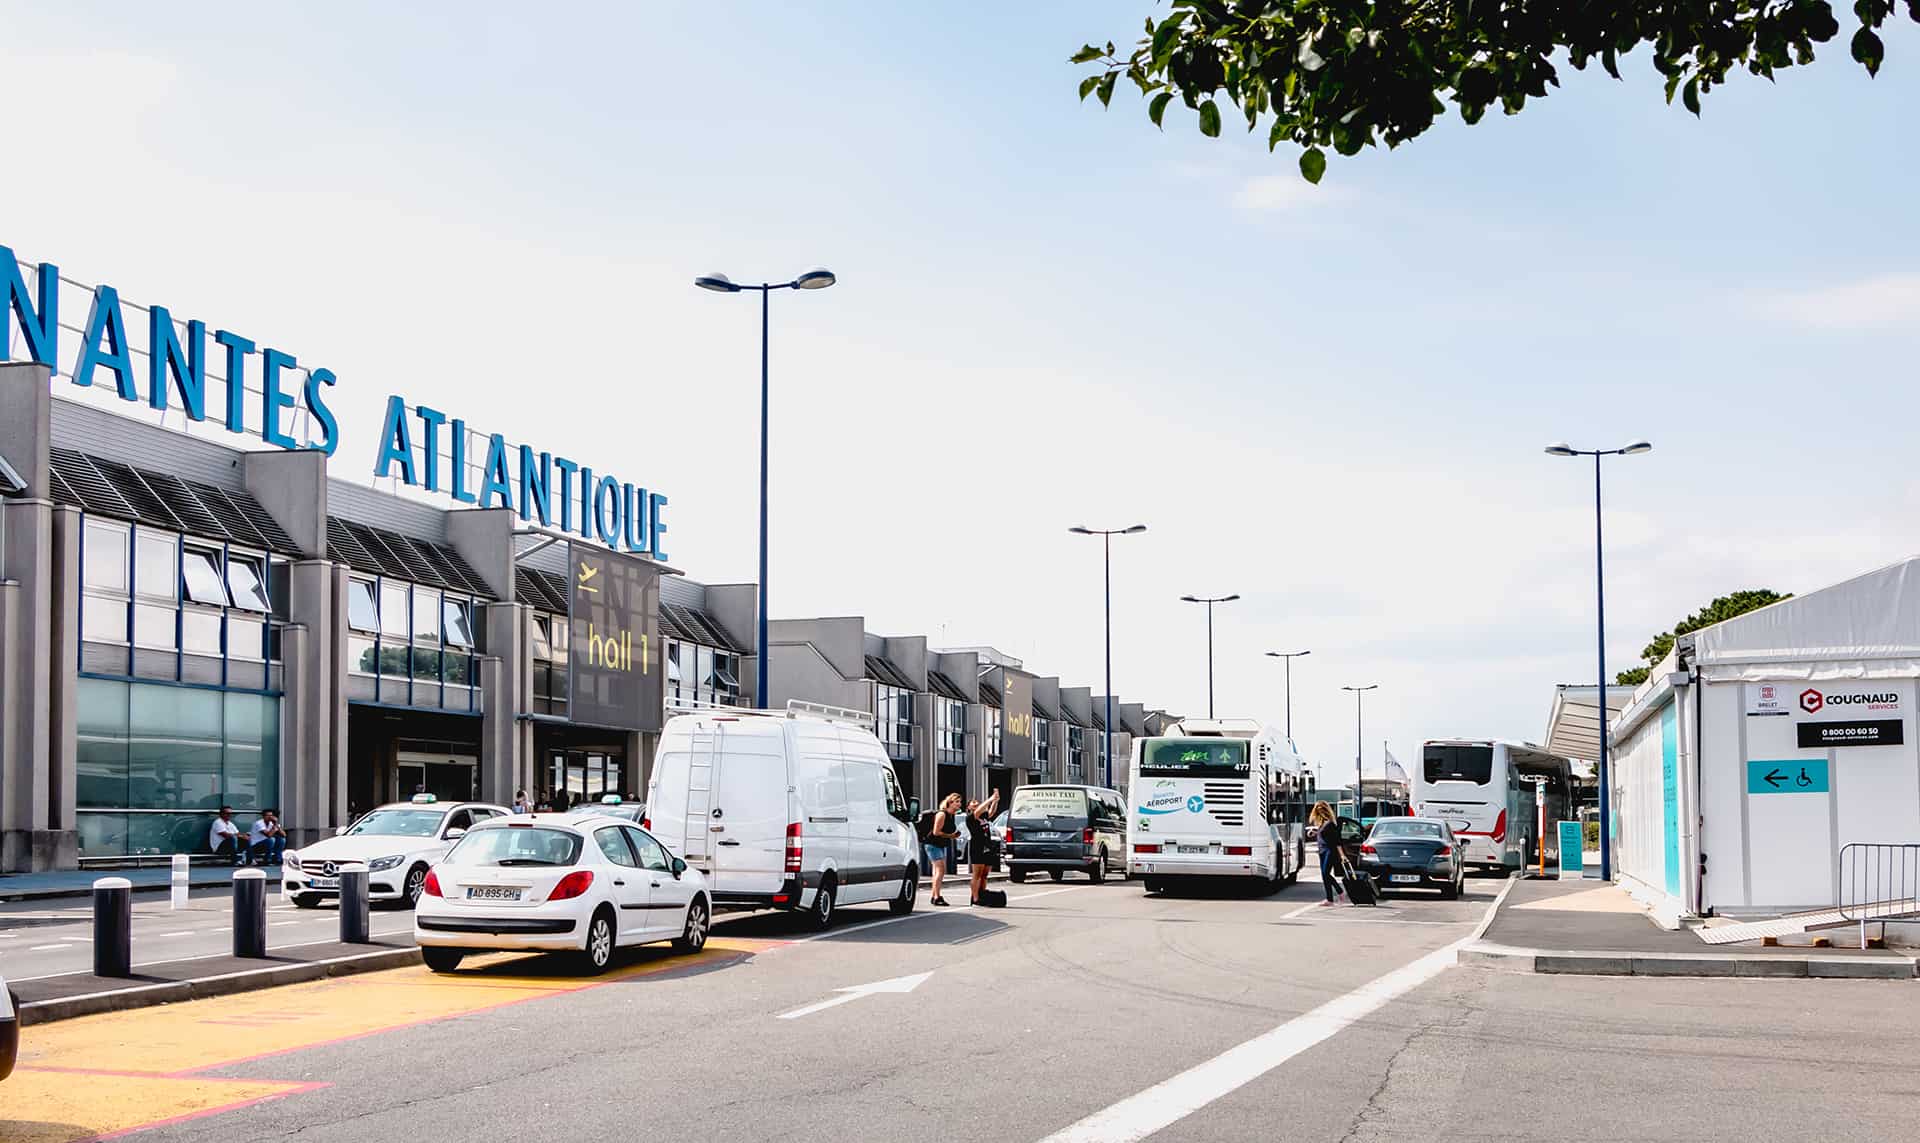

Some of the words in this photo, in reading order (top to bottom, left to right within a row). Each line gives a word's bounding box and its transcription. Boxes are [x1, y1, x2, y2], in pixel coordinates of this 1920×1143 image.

[0, 244, 340, 456] NANTES
[373, 394, 669, 563] ATLANTIQUE
[588, 623, 632, 672] hall
[640, 633, 649, 676] 1
[1826, 693, 1898, 705] COUGNAUD
[1008, 711, 1024, 737] hall
[1024, 713, 1031, 738] 2
[1829, 728, 1845, 736] 800
[1845, 728, 1856, 736] 00
[1234, 763, 1250, 771] 477
